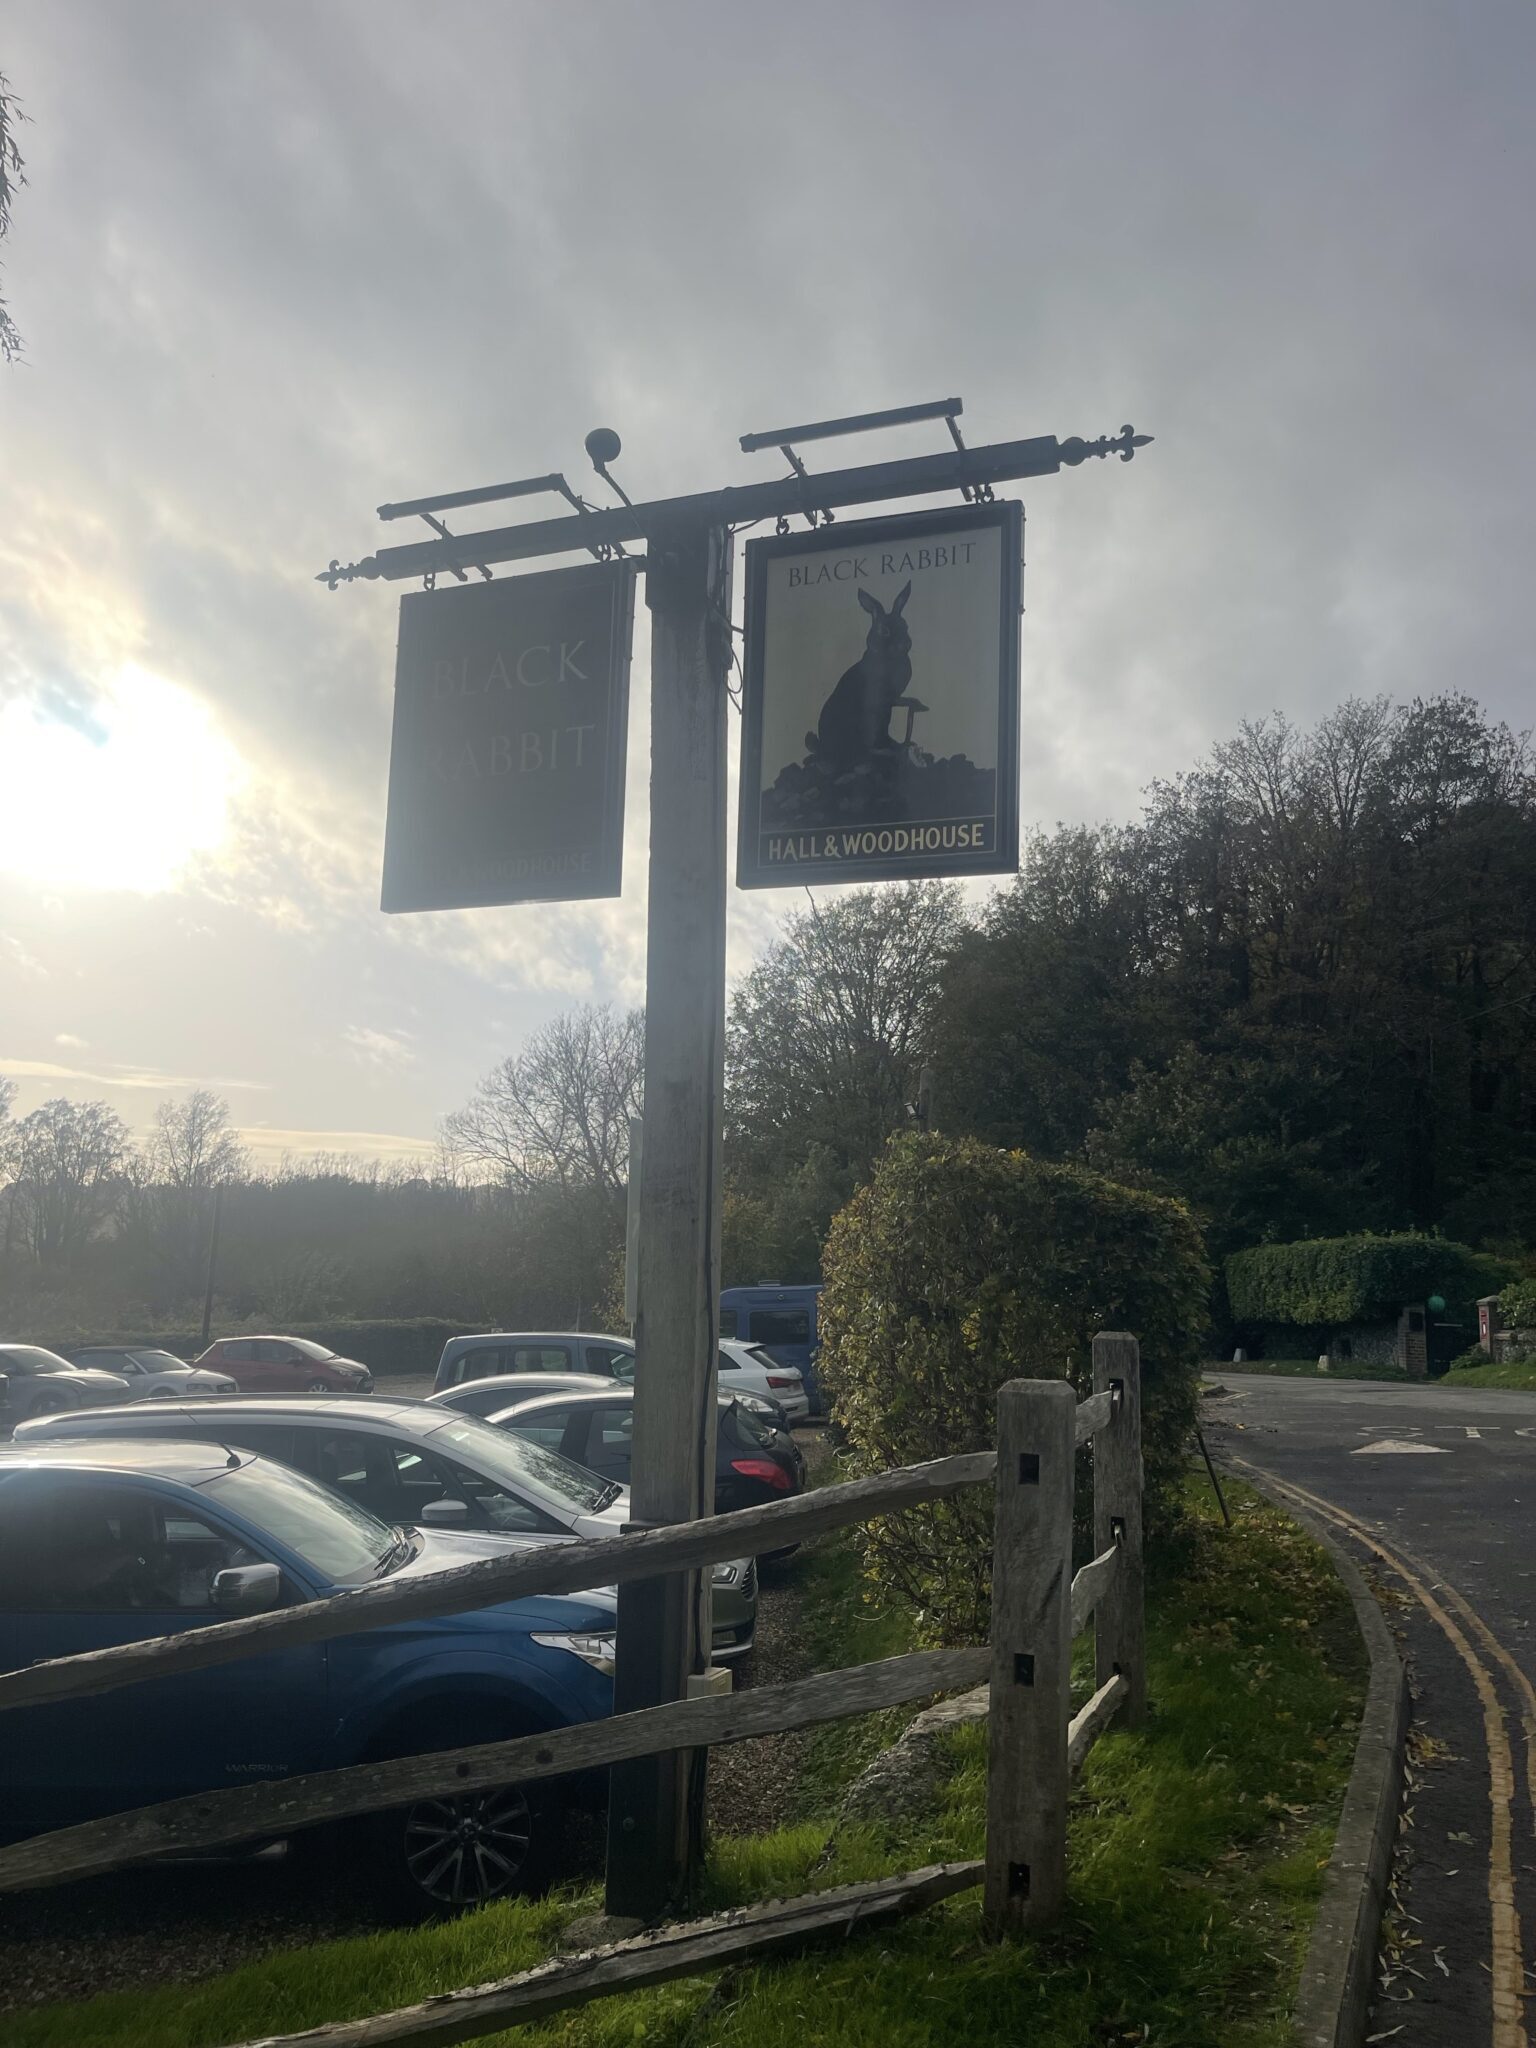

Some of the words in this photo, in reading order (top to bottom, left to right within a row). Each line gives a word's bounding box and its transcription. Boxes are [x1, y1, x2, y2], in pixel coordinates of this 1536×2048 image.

[788, 558, 869, 589] BLACK
[881, 542, 977, 576] RABBIT
[432, 640, 589, 700] BLACK
[424, 723, 596, 783] RABBIT
